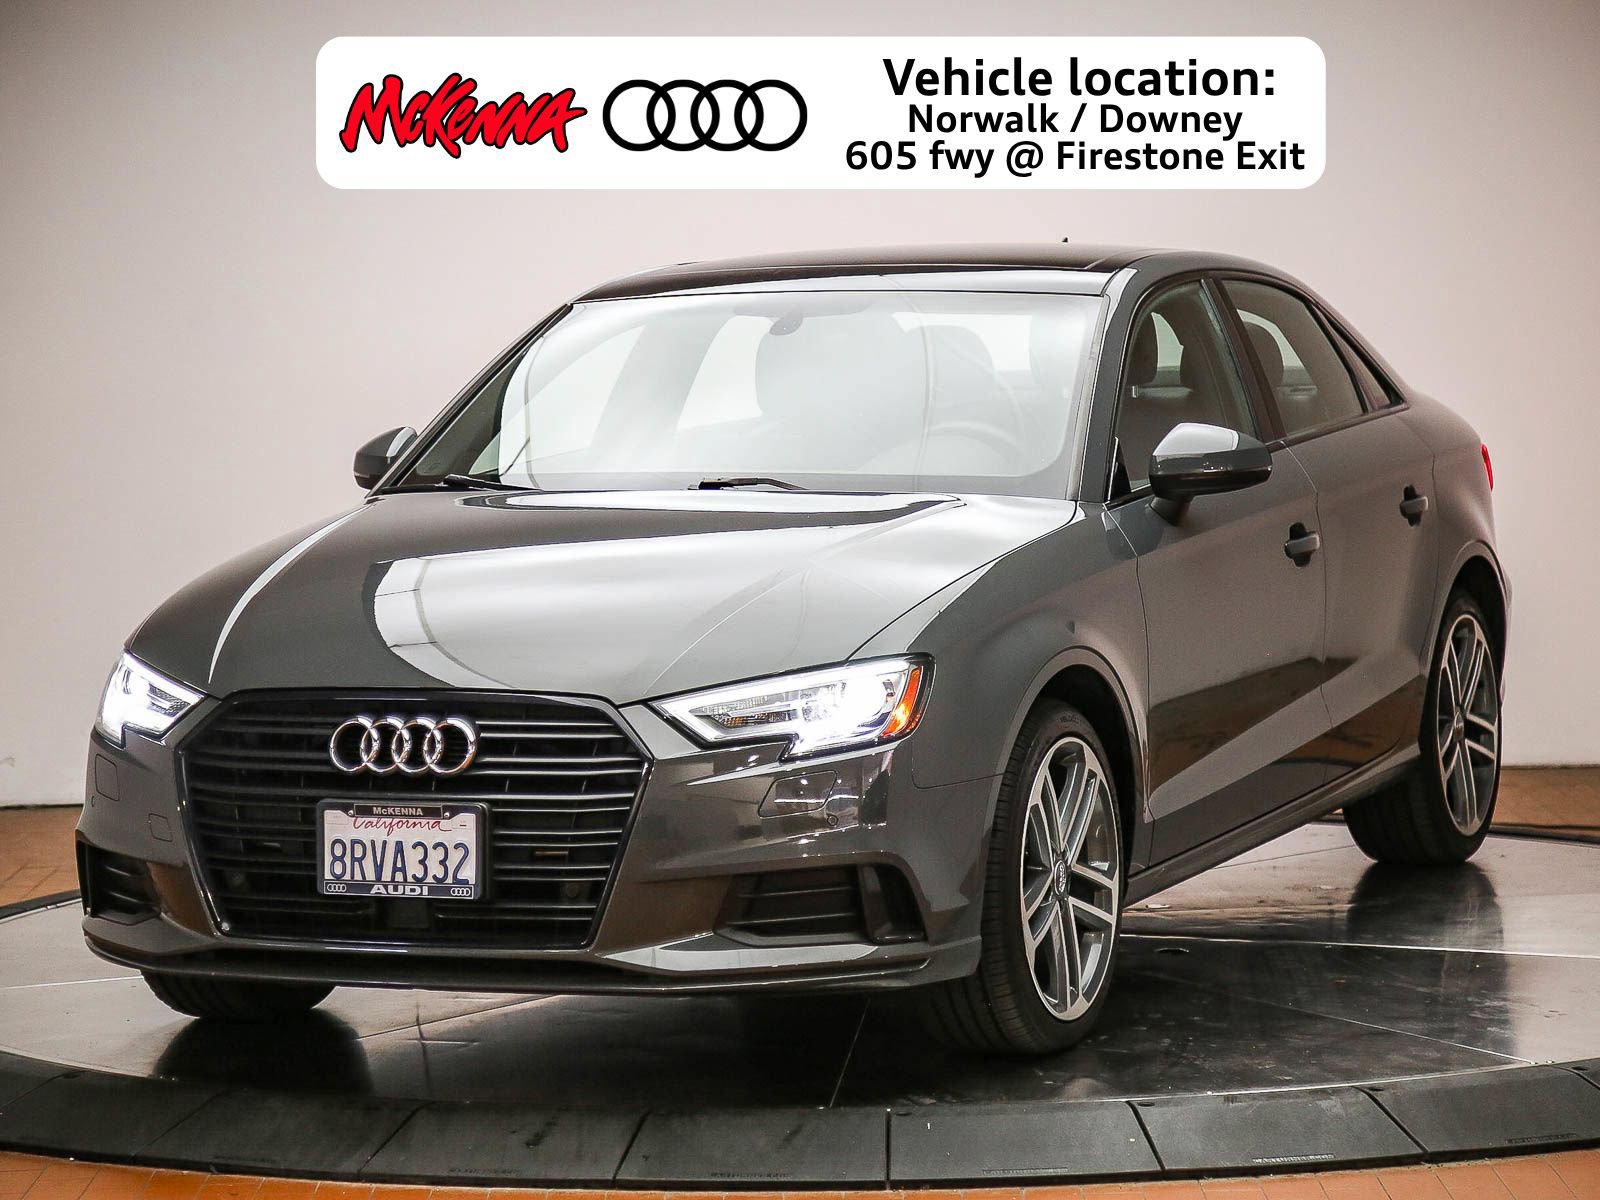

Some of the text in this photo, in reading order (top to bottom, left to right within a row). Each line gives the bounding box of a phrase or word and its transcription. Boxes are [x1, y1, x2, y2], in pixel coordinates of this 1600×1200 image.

[372, 806, 424, 816] McKENNA
[352, 817, 452, 837] California
[329, 838, 470, 885] 8RVA332
[370, 884, 429, 896] AUDI
